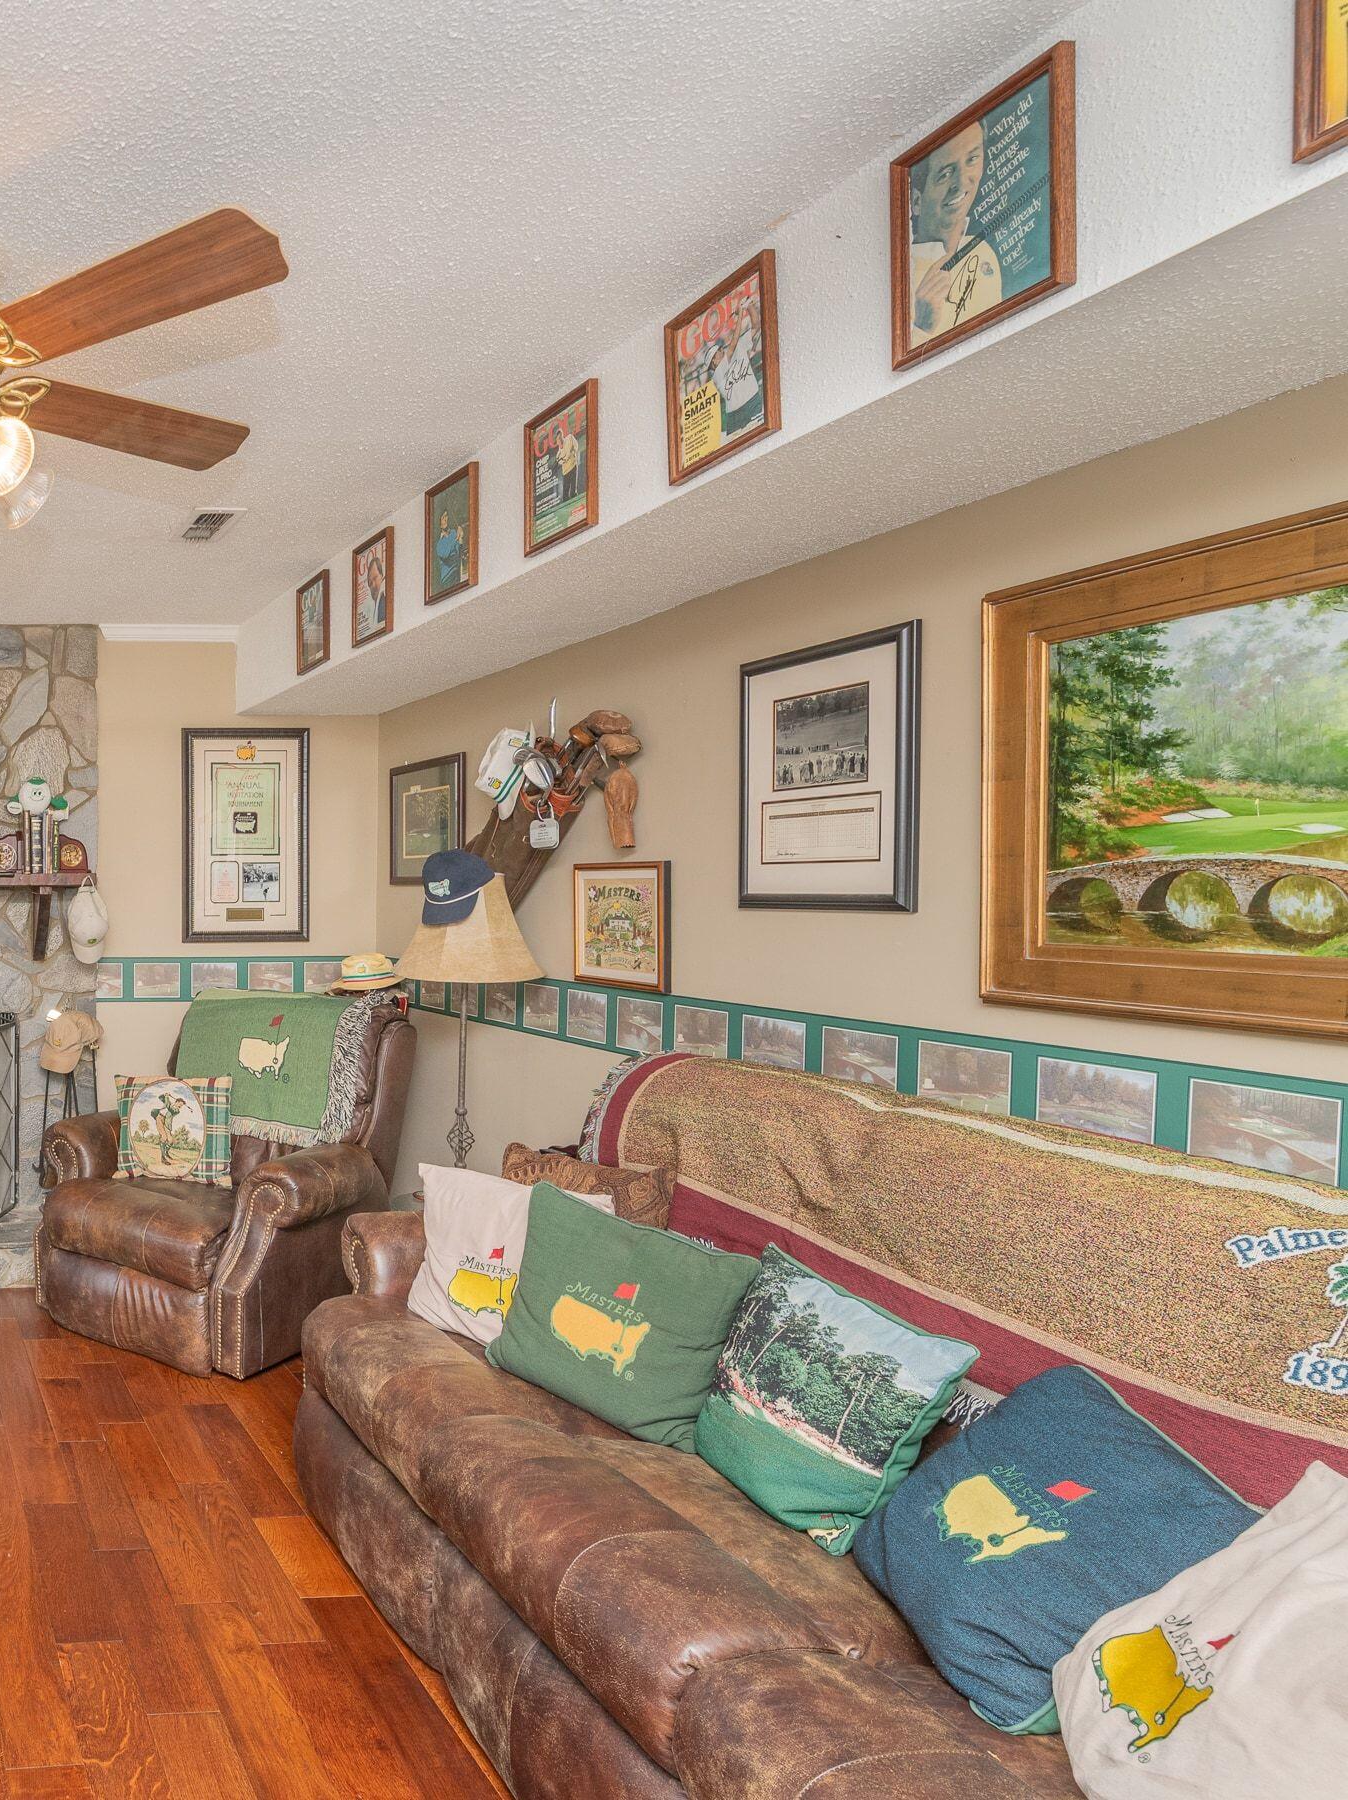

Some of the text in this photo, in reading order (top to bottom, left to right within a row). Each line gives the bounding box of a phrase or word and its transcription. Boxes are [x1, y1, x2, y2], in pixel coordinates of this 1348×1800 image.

[1017, 94, 1034, 116] did
[980, 146, 1030, 196] my favorite
[987, 140, 1020, 175] change
[974, 167, 1026, 220] persimmon
[980, 194, 1008, 225] wood?
[1009, 196, 1042, 231] already
[998, 218, 1035, 255] number
[684, 386, 708, 409] PLAY
[684, 392, 718, 422] SMART
[535, 455, 550, 469] CHIP
